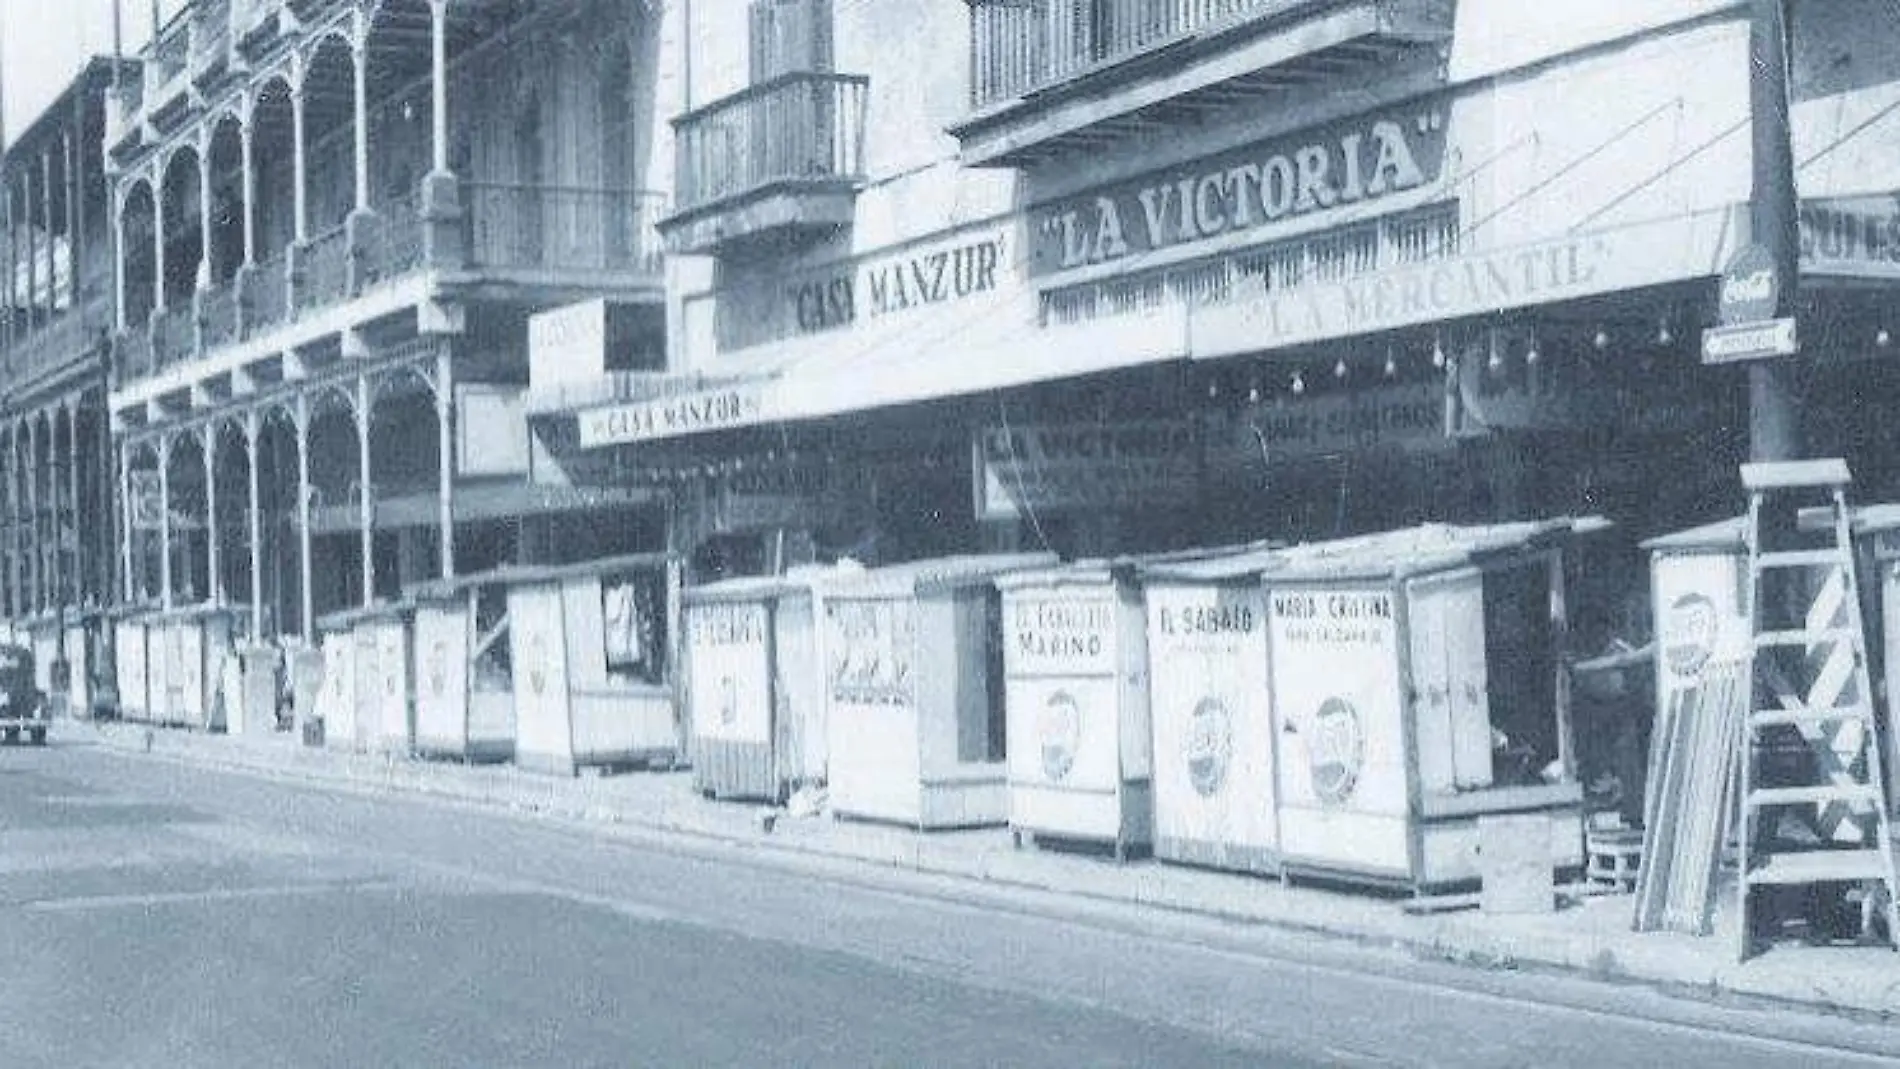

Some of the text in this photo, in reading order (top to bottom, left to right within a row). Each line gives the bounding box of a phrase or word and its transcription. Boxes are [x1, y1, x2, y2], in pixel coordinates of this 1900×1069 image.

[1139, 109, 1442, 247] VICTORIA"
[1275, 597, 1317, 619] MARIA
[1018, 631, 1101, 657] MARINO
